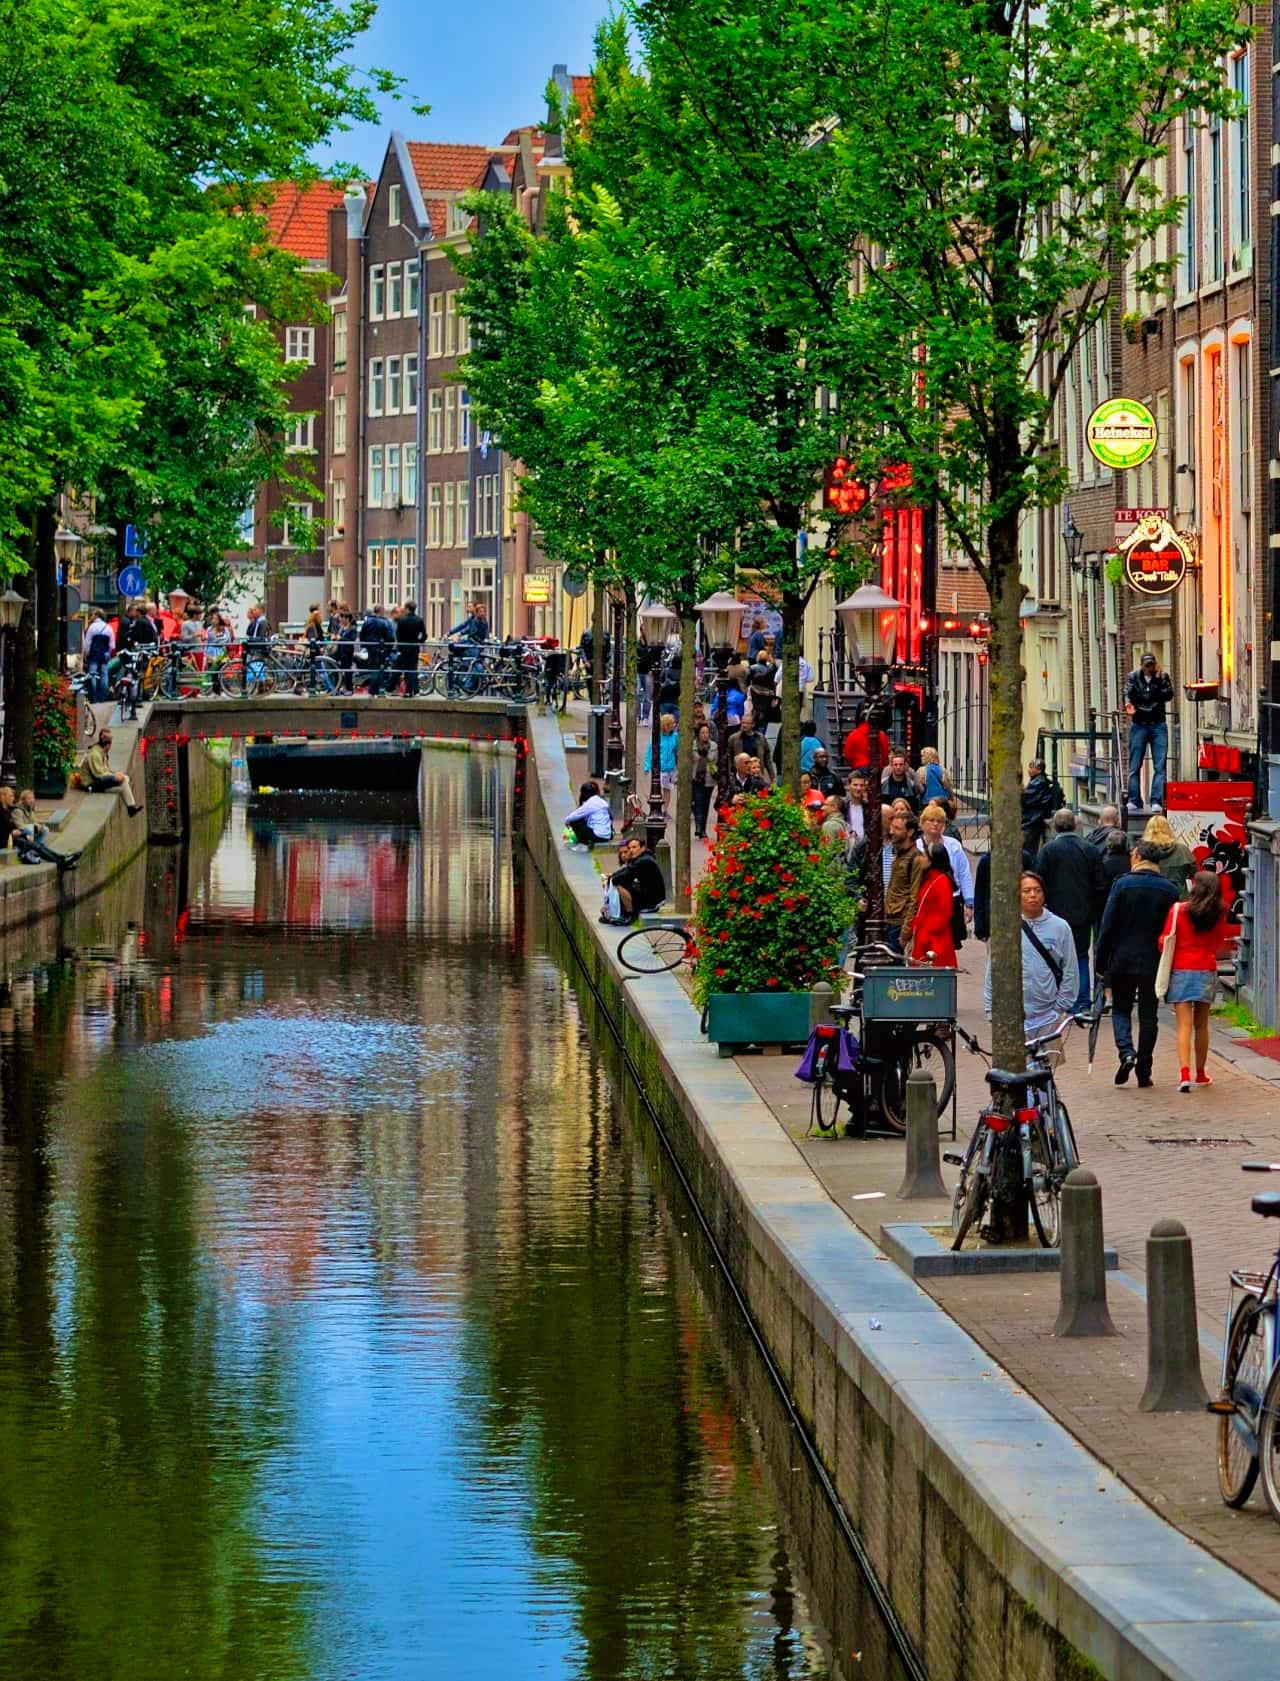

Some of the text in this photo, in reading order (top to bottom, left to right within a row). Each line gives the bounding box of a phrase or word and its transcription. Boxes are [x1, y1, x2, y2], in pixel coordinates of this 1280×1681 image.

[1094, 425, 1151, 439] Heineken
[1115, 510, 1133, 521] TE
[1142, 560, 1169, 571] BAR
